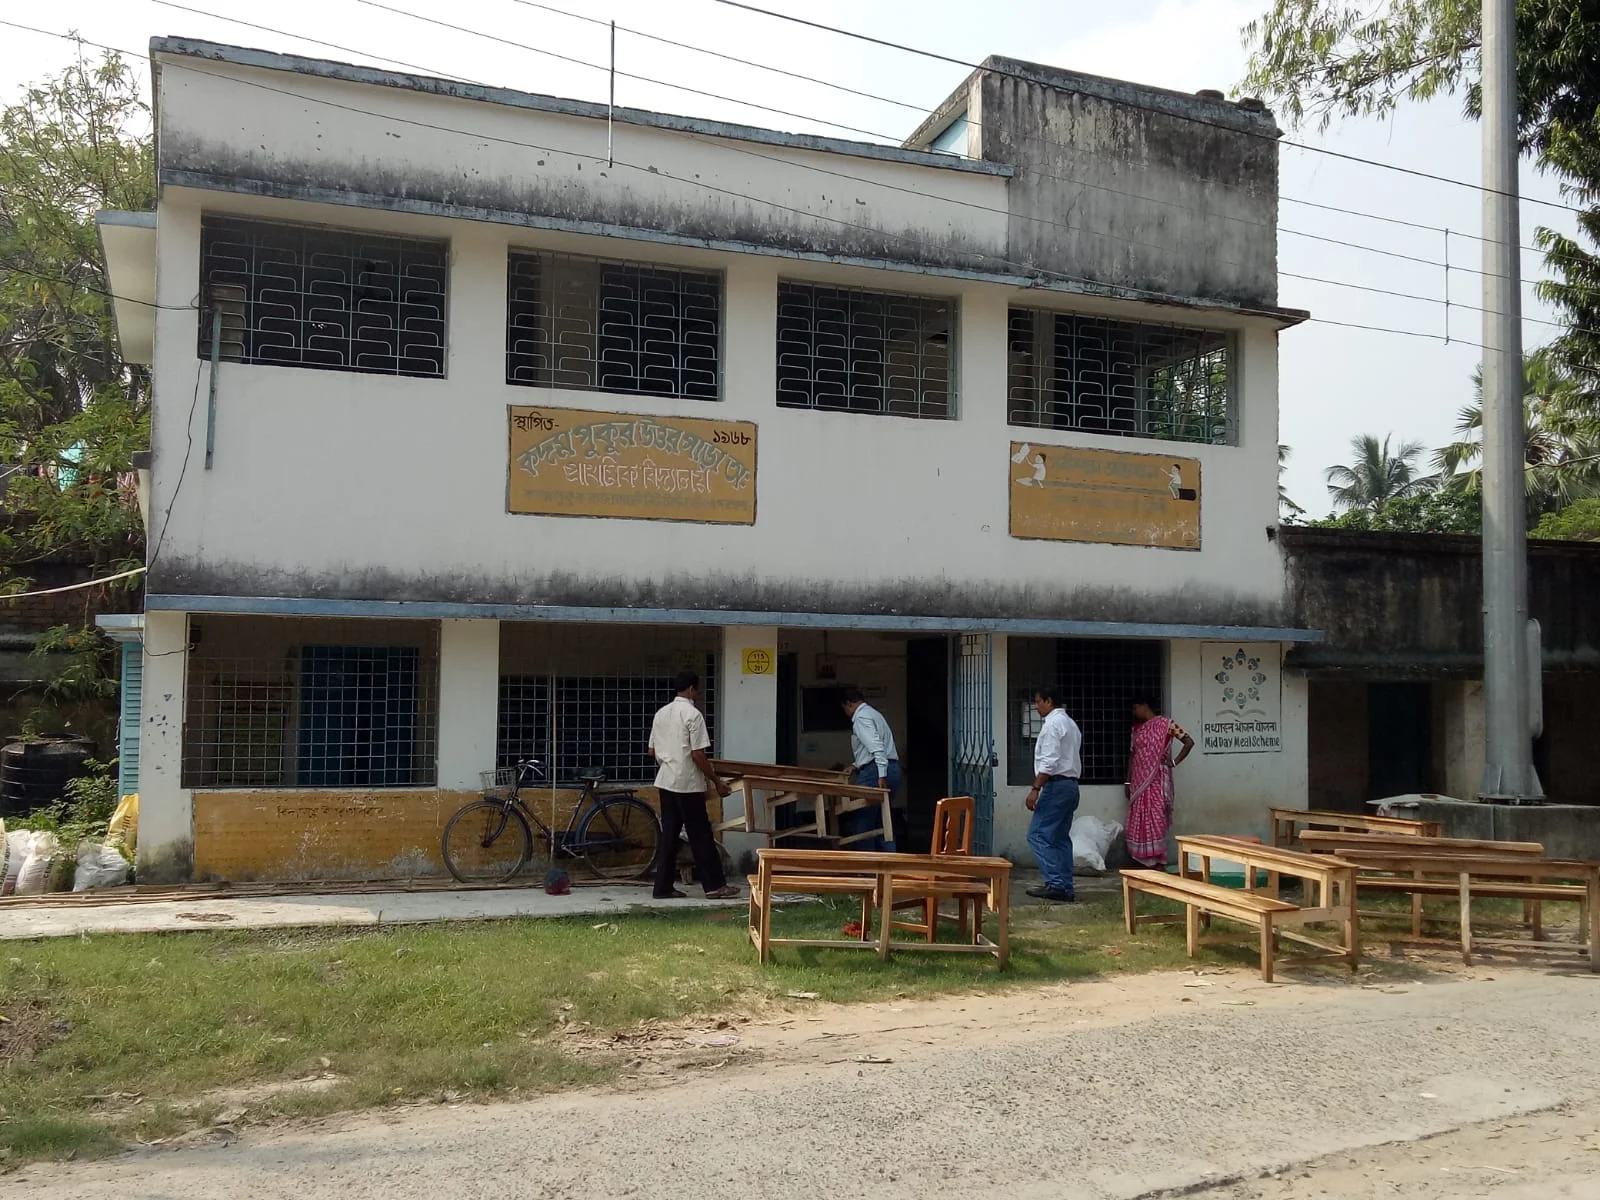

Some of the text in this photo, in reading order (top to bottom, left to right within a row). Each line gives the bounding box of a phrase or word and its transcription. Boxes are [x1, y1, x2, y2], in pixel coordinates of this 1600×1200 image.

[712, 429, 752, 446] ১৯৬৮
[1204, 735, 1280, 748] Mid Day Meal Scheme
